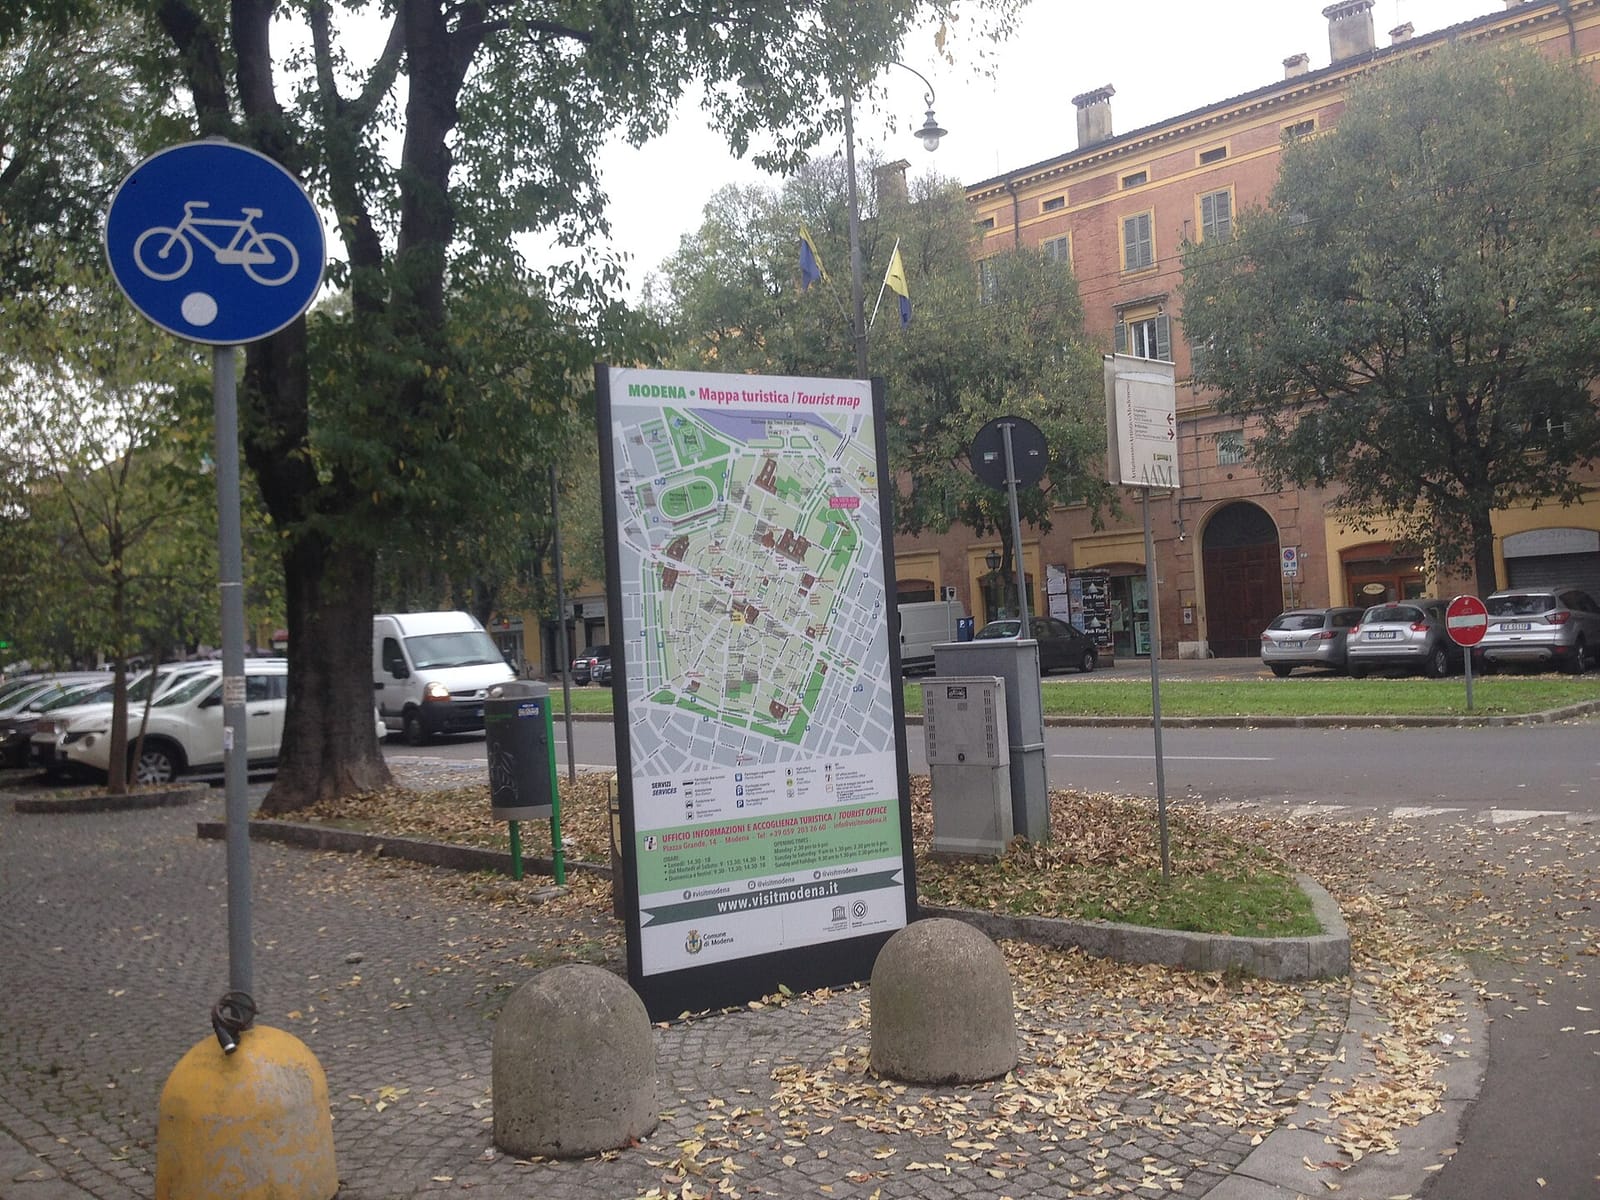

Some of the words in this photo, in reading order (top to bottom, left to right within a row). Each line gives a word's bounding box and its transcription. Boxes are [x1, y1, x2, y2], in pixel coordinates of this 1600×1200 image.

[628, 384, 687, 399] MODENA
[699, 387, 740, 405] Mappa
[741, 389, 789, 404] turistica
[797, 391, 835, 406] Tourist
[836, 396, 861, 410] map
[1141, 463, 1173, 486] AAM
[651, 781, 672, 789] SERVIZI
[652, 787, 677, 796] SERVICES
[662, 831, 691, 843] UFFICIO
[693, 824, 745, 839] INFORMAZIONI
[747, 823, 751, 832] E
[753, 818, 799, 831] ACCOGLIENZA
[800, 813, 833, 825] TURISTICA
[839, 808, 865, 820] TOURIST
[866, 806, 887, 816] OFFICE
[663, 843, 682, 852] Piazza
[709, 838, 717, 846] 14
[725, 835, 749, 844] Modena
[833, 815, 887, 829] info@visitmodena.it
[717, 881, 839, 912] www.visitmodena.it
[702, 931, 727, 941] Comune
[703, 940, 710, 948] di
[711, 937, 734, 946] Modena
